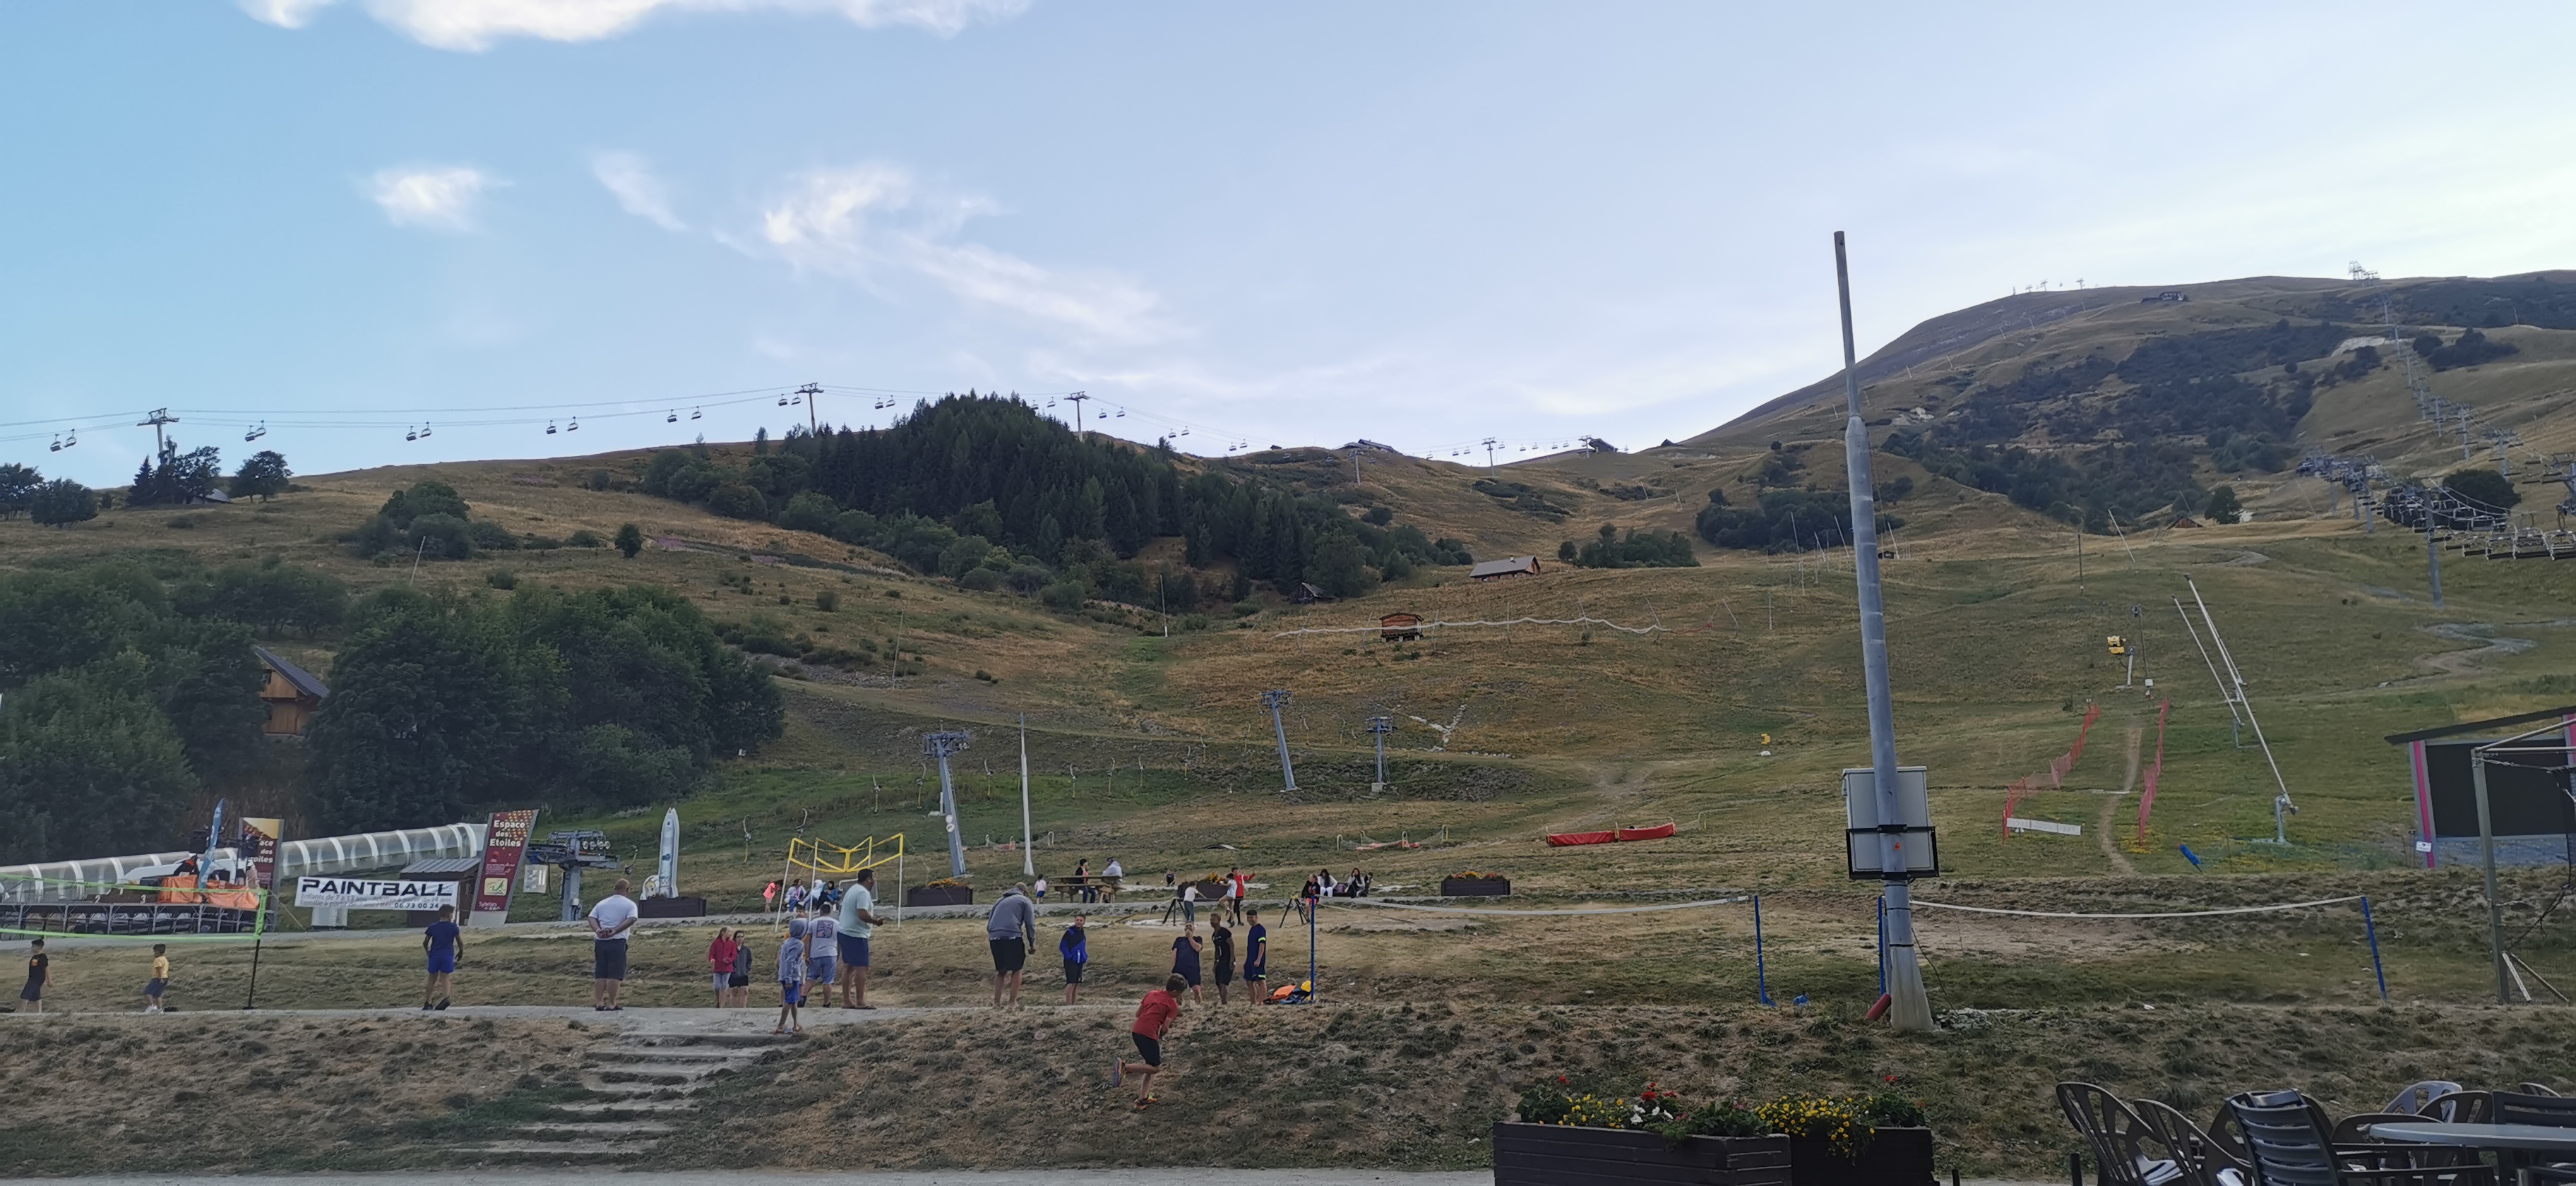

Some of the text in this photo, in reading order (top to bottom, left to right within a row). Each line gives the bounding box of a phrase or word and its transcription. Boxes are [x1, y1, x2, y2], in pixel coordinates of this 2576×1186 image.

[494, 820, 525, 829] Espace
[489, 839, 521, 847] Etoiles
[302, 879, 452, 897] PAINTBALL
